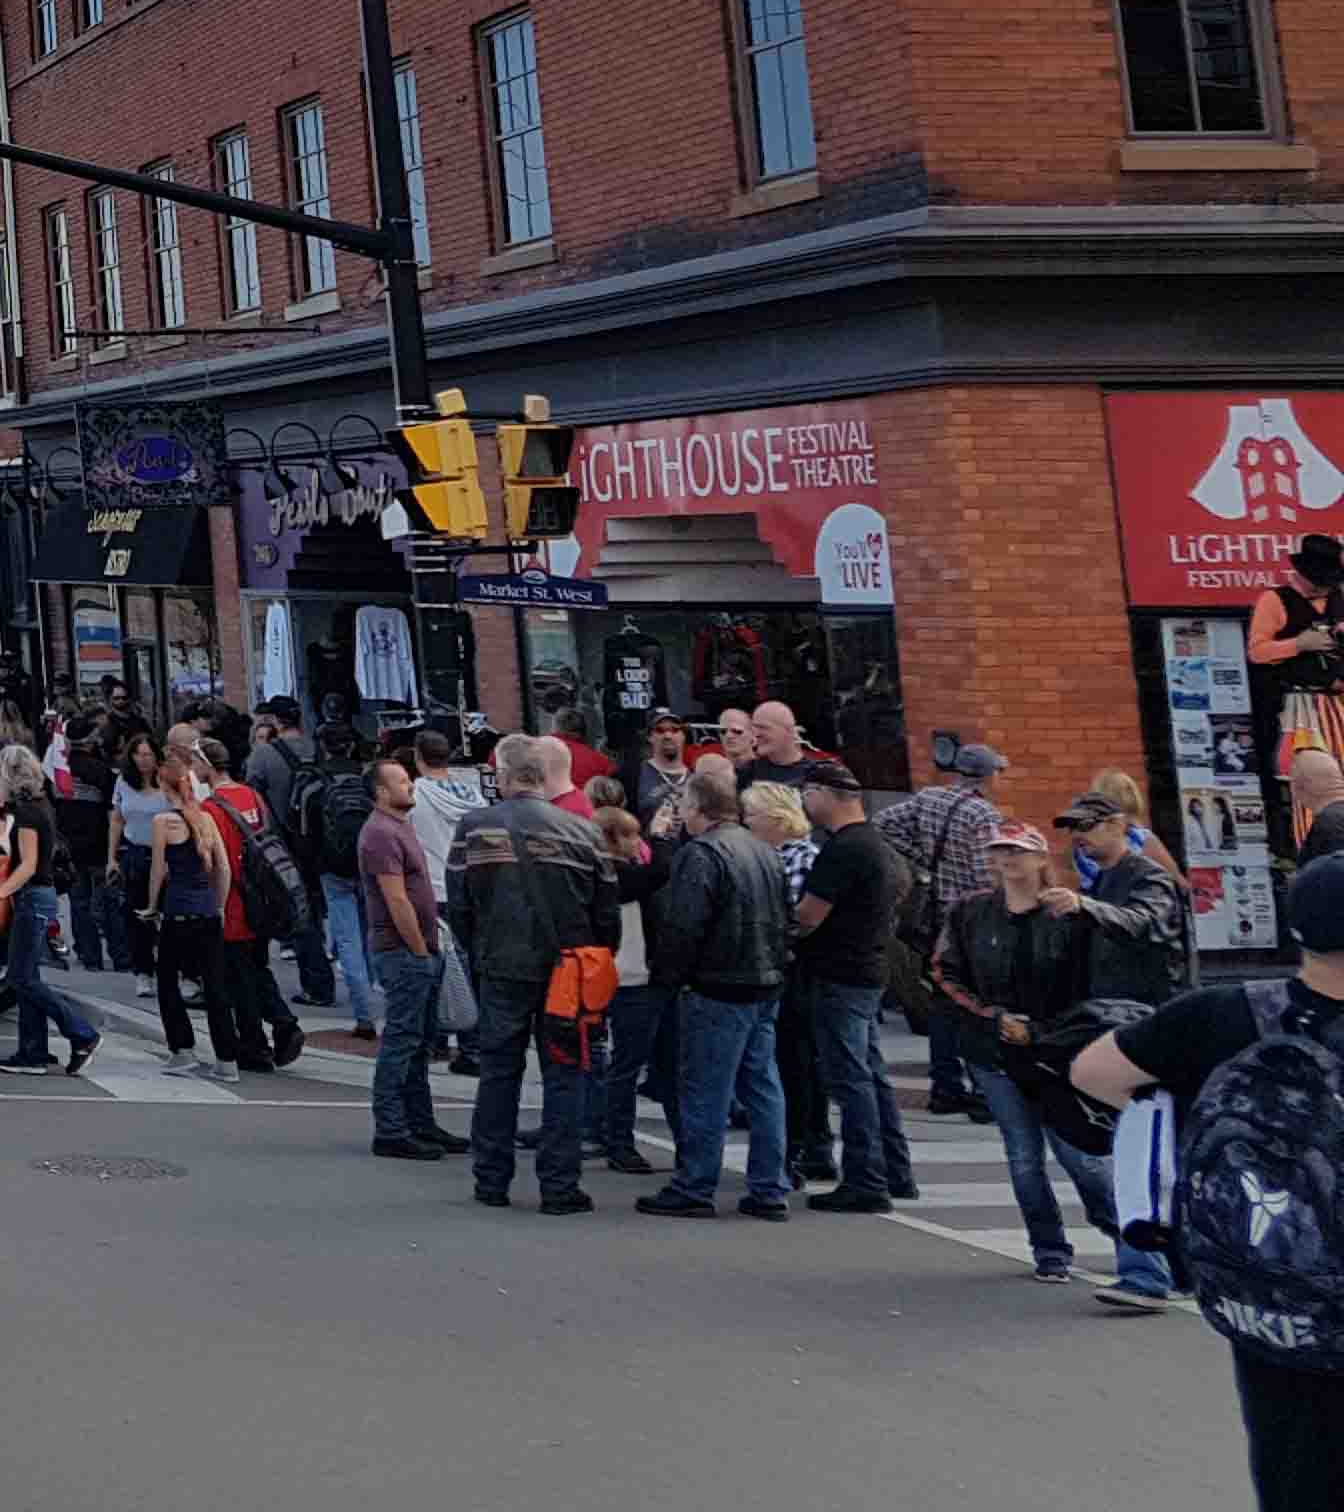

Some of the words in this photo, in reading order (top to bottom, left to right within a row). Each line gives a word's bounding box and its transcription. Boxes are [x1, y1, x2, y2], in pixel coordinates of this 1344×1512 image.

[787, 421, 873, 455] FESTIVAL
[565, 427, 789, 503] iGHTHOUSE
[790, 454, 879, 488] THEATRE
[840, 561, 882, 589] LIVE
[1187, 569, 1281, 589] FESTIVAL
[479, 582, 529, 599] Market
[531, 586, 553, 601] St.
[558, 587, 593, 604] West
